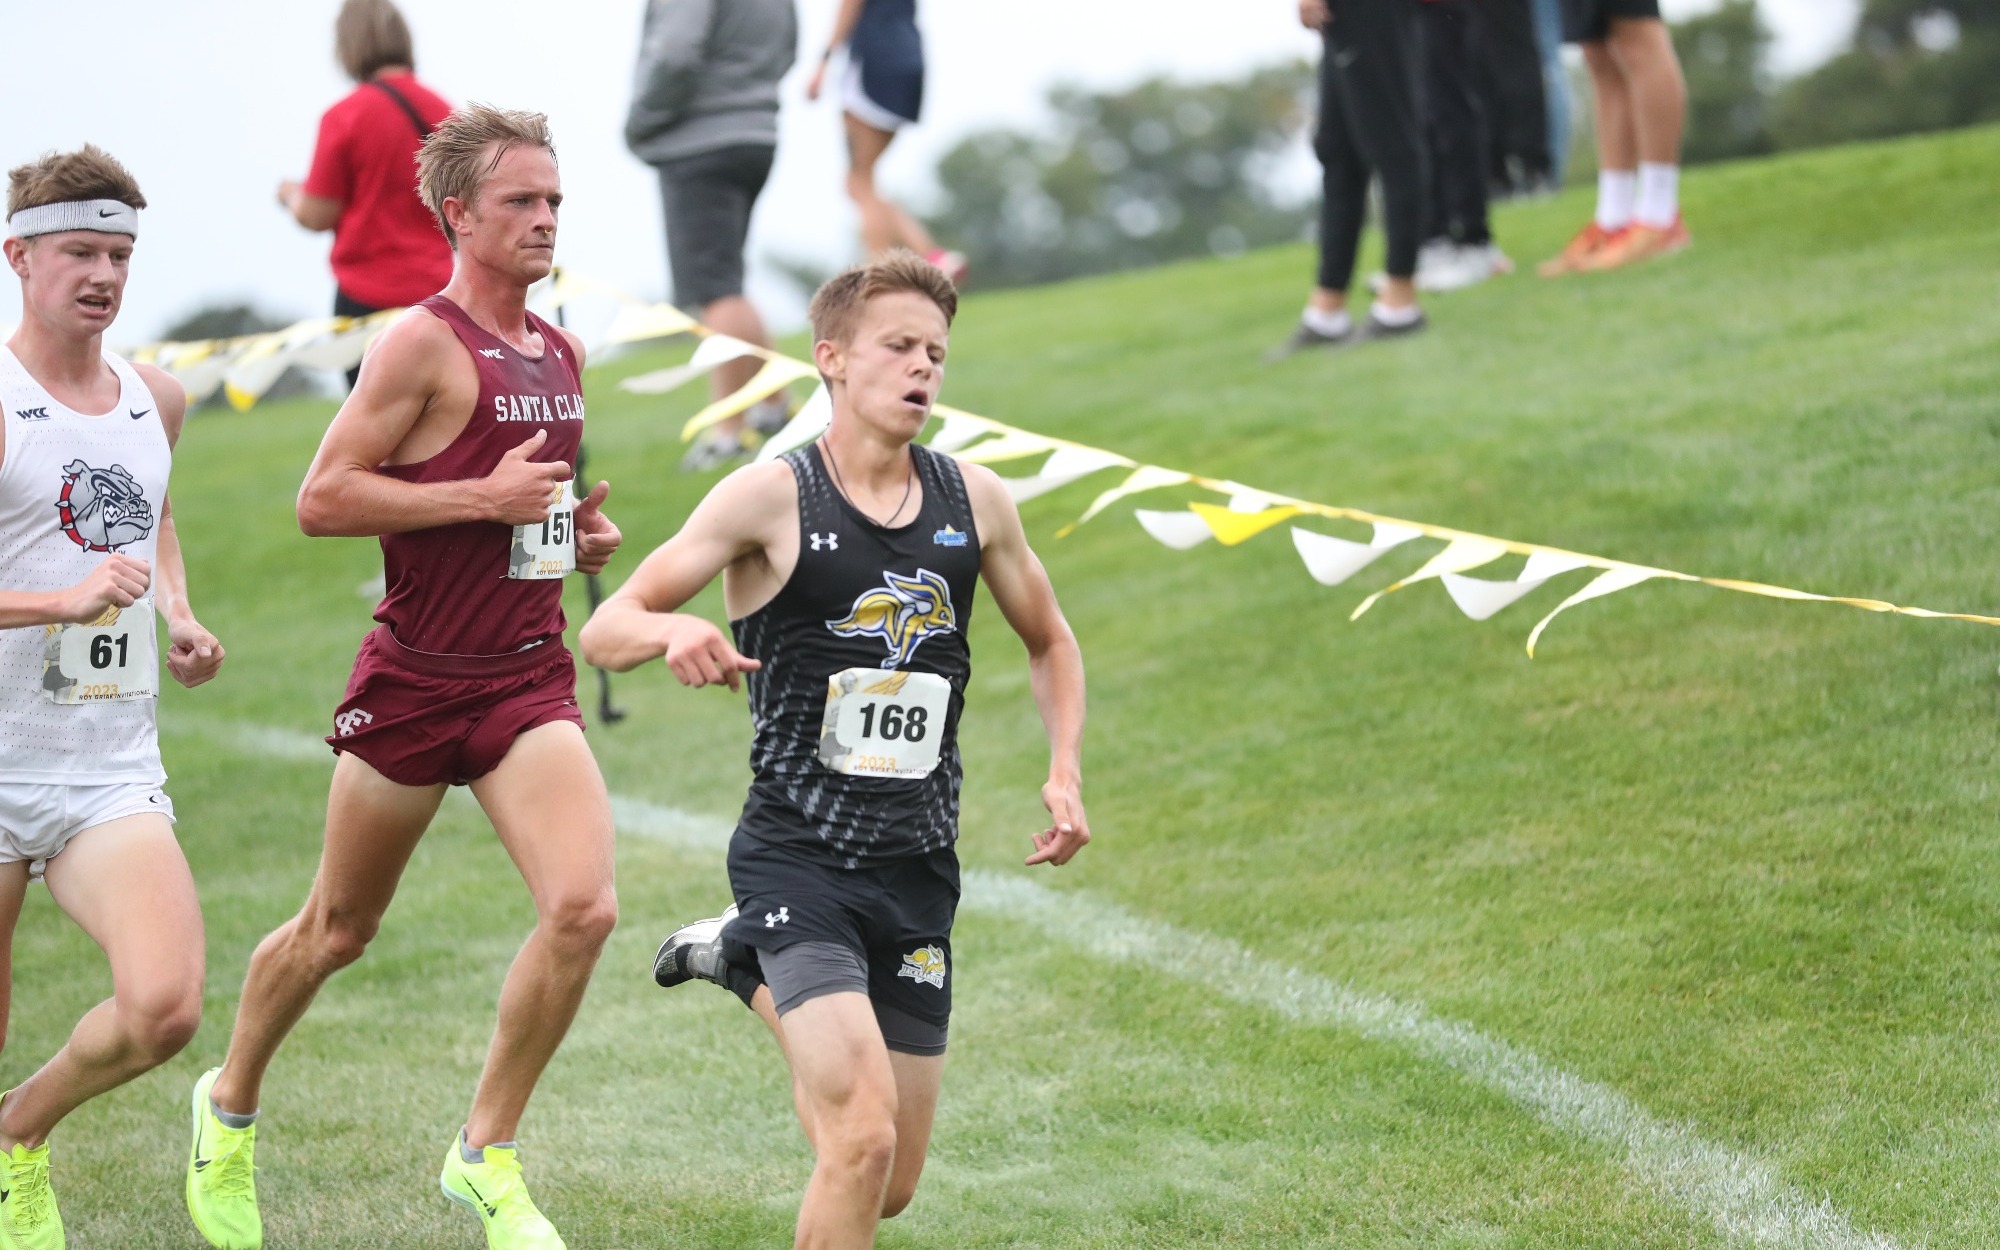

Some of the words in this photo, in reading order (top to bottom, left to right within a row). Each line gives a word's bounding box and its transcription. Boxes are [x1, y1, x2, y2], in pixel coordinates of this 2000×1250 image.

[16, 406, 50, 420] WCC
[494, 394, 554, 422] SANTA
[541, 511, 571, 546] 157
[539, 560, 563, 572] 2023
[90, 632, 129, 669] 61
[83, 684, 119, 698] 2023
[859, 702, 928, 743] 168
[858, 754, 896, 770] 2023
